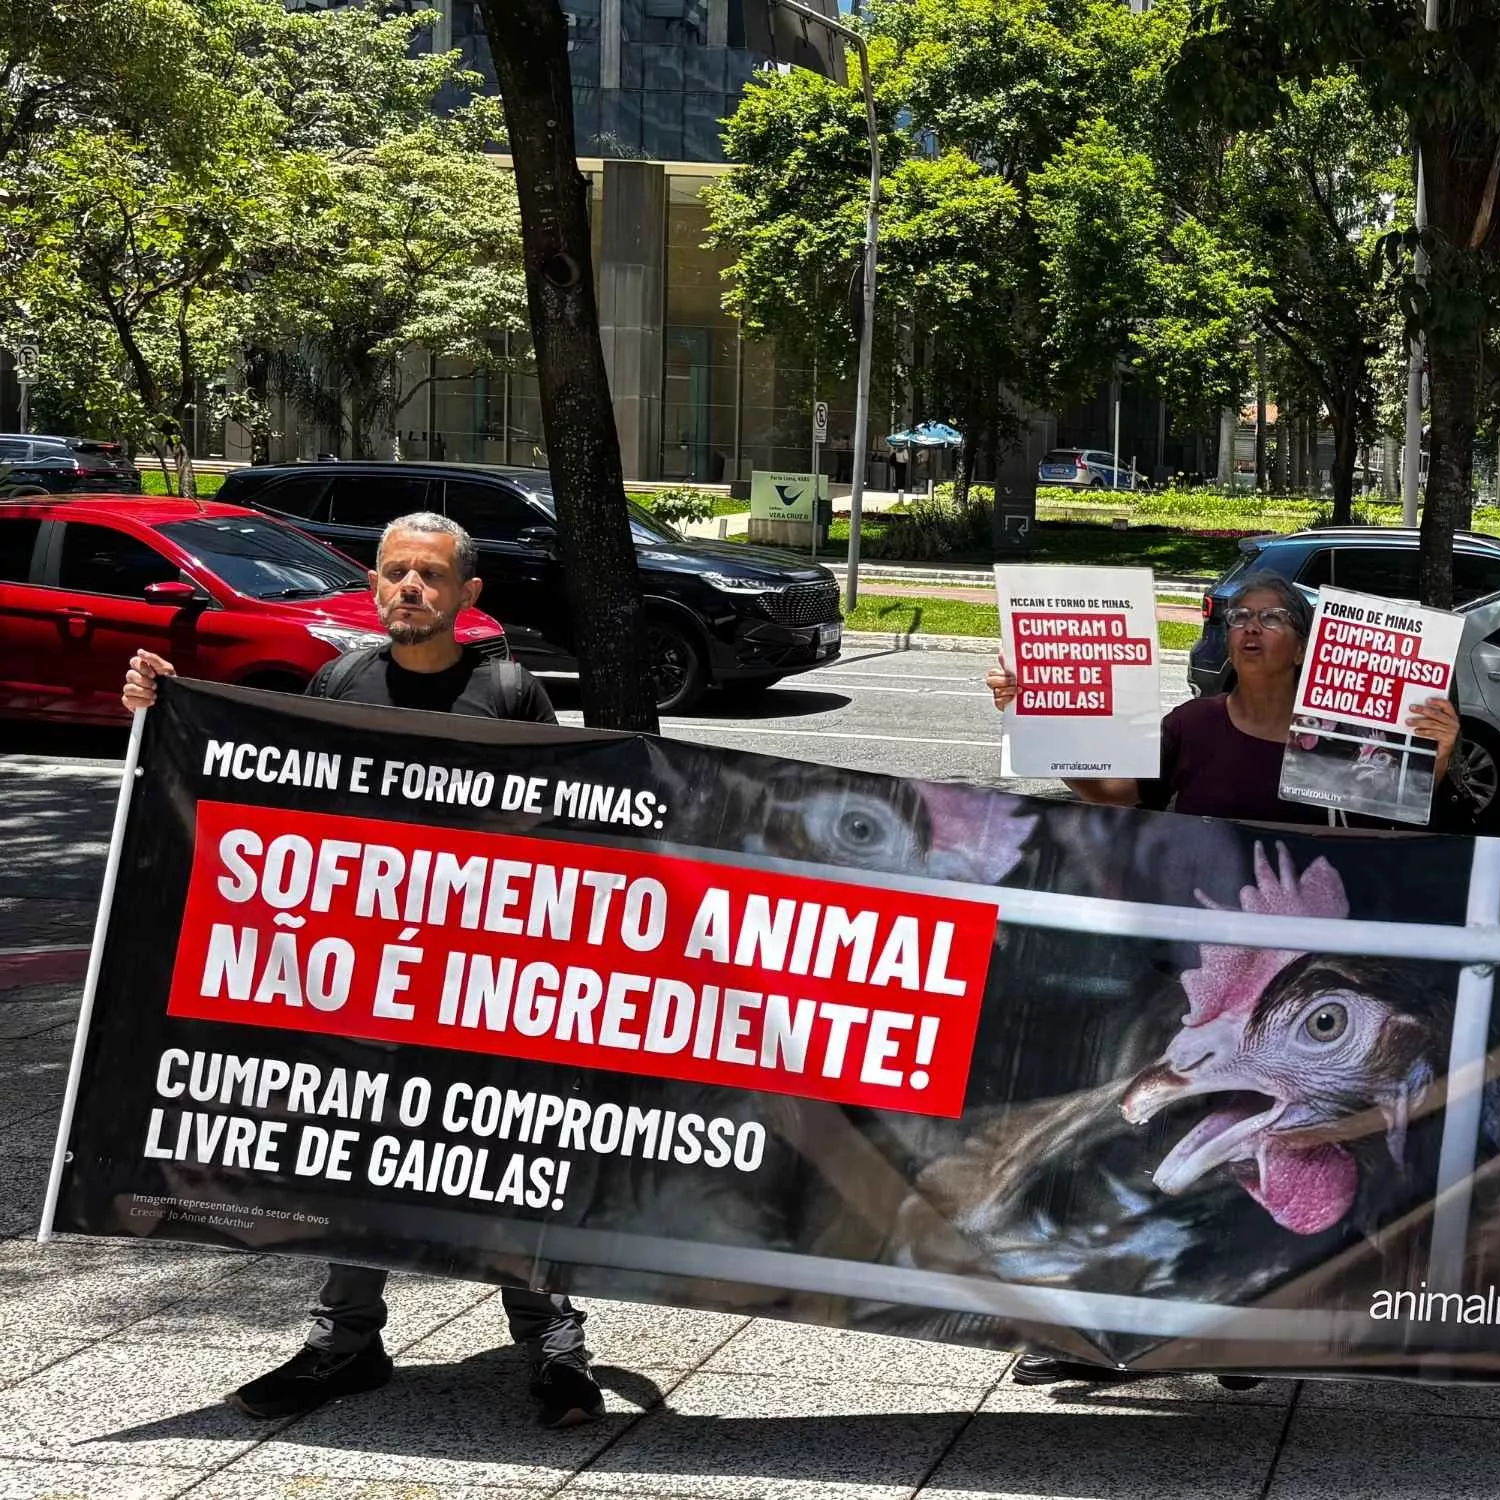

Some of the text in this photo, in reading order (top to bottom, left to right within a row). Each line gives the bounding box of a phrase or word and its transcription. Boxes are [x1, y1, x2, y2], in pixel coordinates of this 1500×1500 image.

[1010, 598, 1045, 608] MCCAIN
[1048, 598, 1053, 608] E
[1055, 598, 1086, 608] FORNO
[1088, 599, 1100, 608] DE
[1323, 601, 1423, 633] FORNO DE MINAS
[1019, 618, 1123, 637] CUMPRAM O
[1324, 622, 1414, 657] CUMPRA O
[1021, 642, 1148, 661] COMPROMISSO
[1319, 643, 1445, 685] COMPROMISSO
[1023, 666, 1102, 685] LIVRE DE
[1314, 664, 1395, 698] LIVRE DE
[1023, 691, 1105, 709] GAIOLAS!
[1310, 686, 1393, 719] GAIOLAS!
[202, 739, 667, 828] MCCAIN E FORNO DE MINAS:
[216, 829, 967, 996] SOFRIMENTO ANIMAL
[200, 912, 942, 1091] NÃO É INGREDIENTE!
[155, 1048, 767, 1172] CUMPRAM O COMPROMISSO
[143, 1109, 571, 1212] LIVRE DE GAIOLAS!
[133, 1193, 330, 1225] Imagem representativa do setor de ovos
[180, 1212, 206, 1224] Anne
[209, 1215, 254, 1229] McArthur
